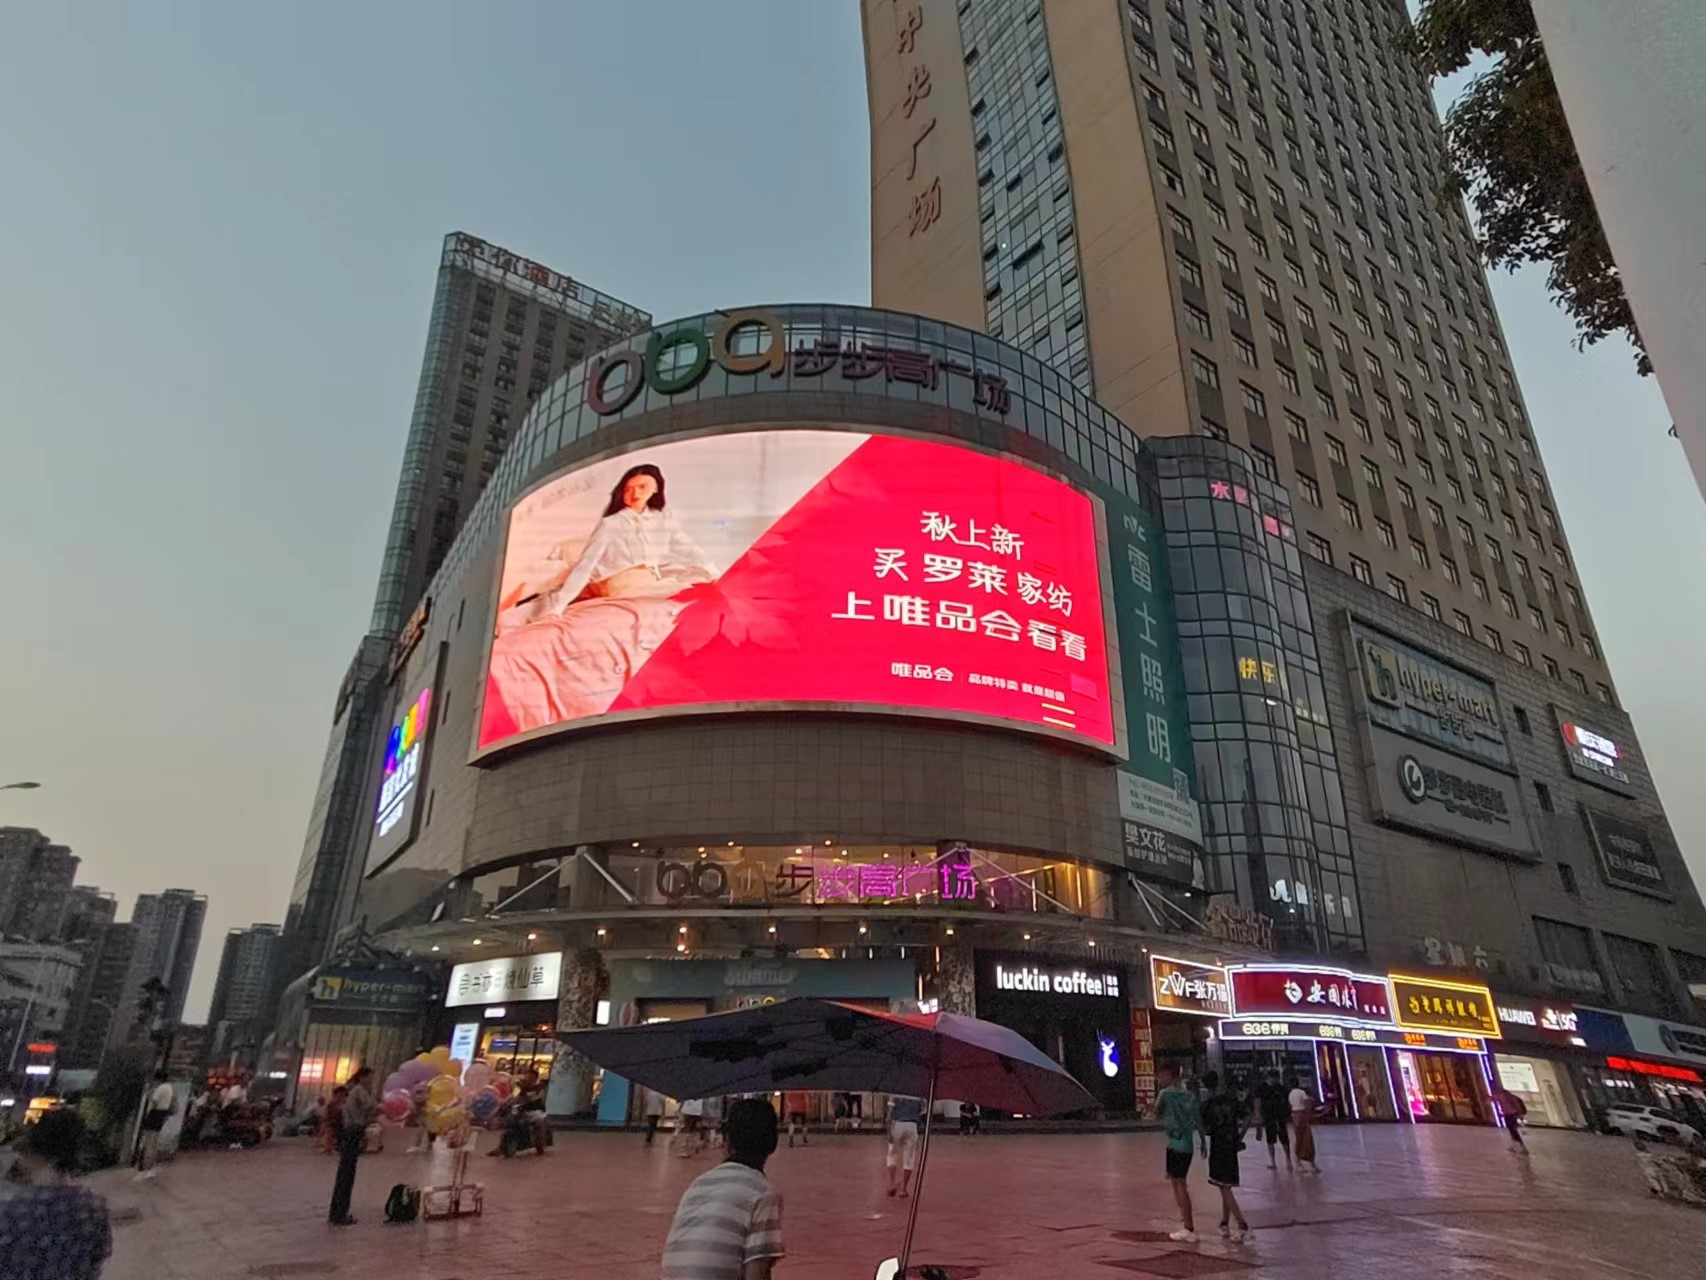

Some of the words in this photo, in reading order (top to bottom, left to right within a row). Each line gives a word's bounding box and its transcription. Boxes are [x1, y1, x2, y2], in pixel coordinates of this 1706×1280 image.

[794, 338, 1011, 416] 步步高广场
[920, 510, 1025, 560] 秋上新
[831, 591, 1087, 662] 上唯品会看看
[891, 662, 954, 683] 唯品会
[1127, 544, 1171, 763] 雷士照明
[775, 863, 977, 900] 步步高广场
[996, 965, 1050, 992] luckin
[1053, 970, 1102, 996] coffee
